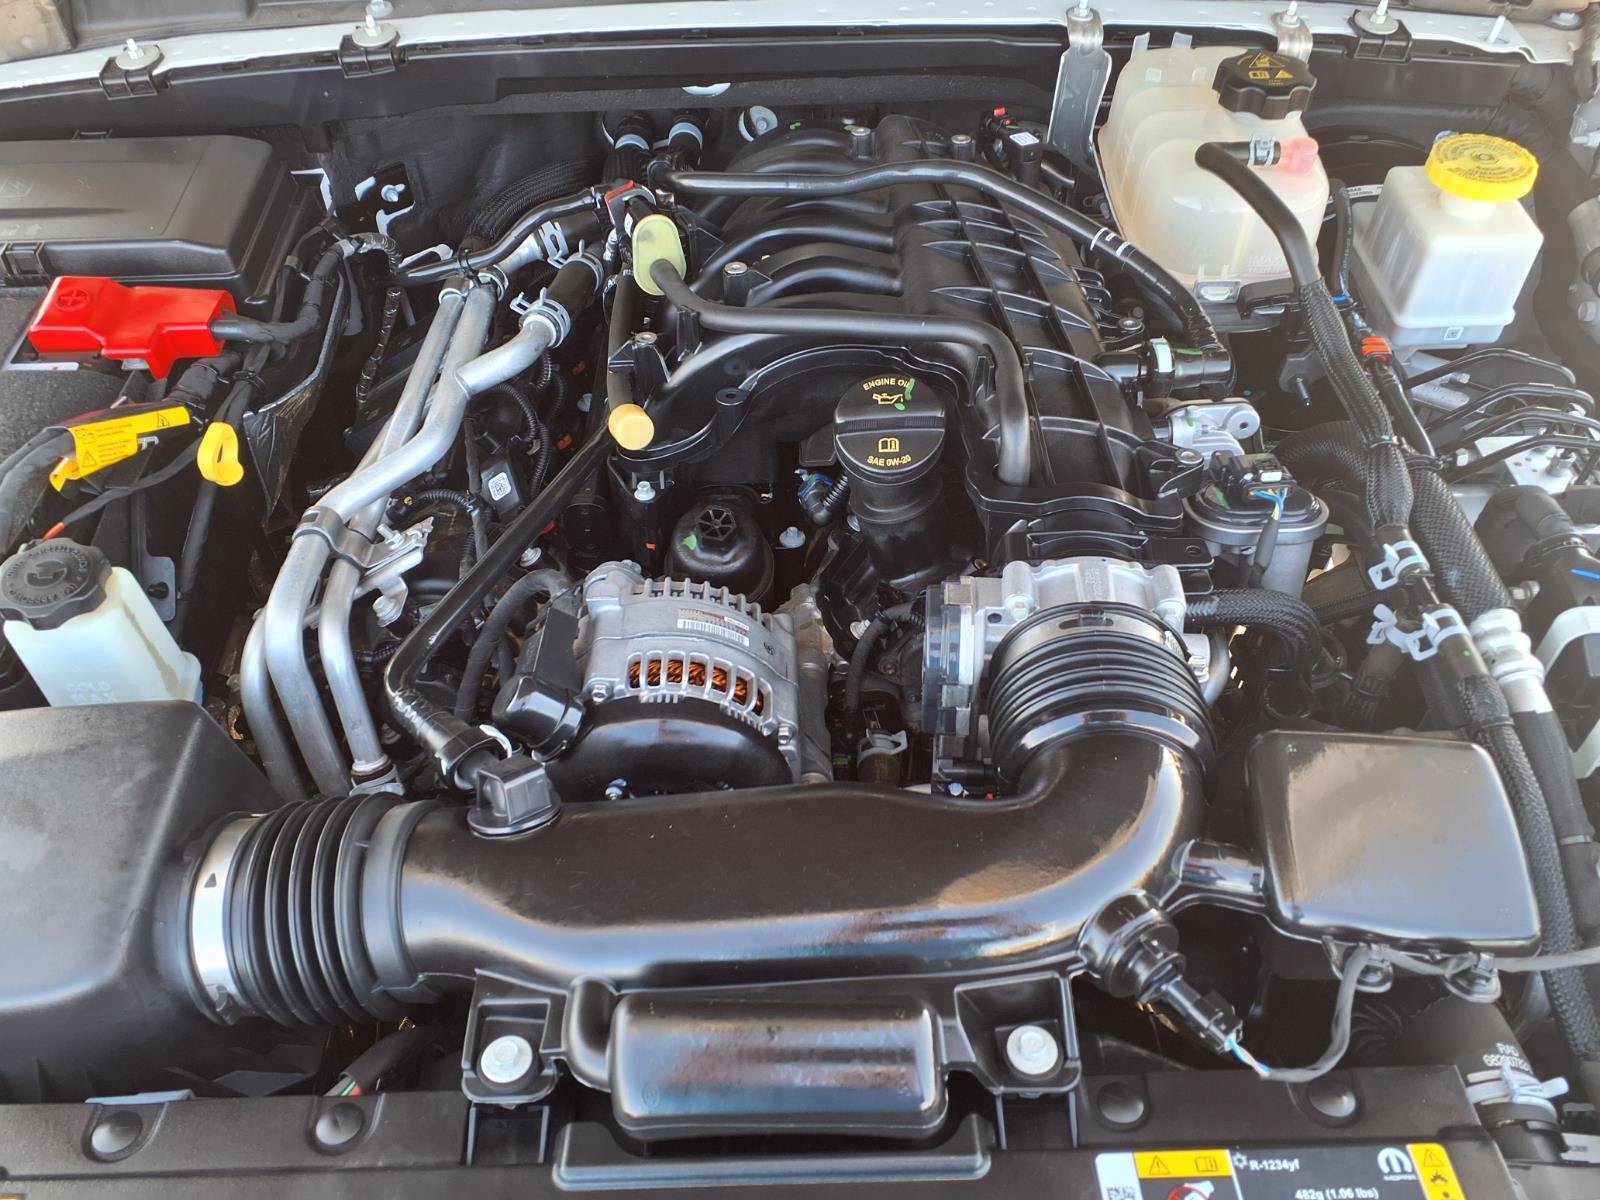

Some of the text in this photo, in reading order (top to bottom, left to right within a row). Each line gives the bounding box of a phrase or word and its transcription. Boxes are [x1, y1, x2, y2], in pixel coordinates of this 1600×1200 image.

[863, 378, 895, 391] ENGINE
[867, 454, 912, 467] SAE 0W-20
[1249, 1158, 1299, 1172] R-1234yf
